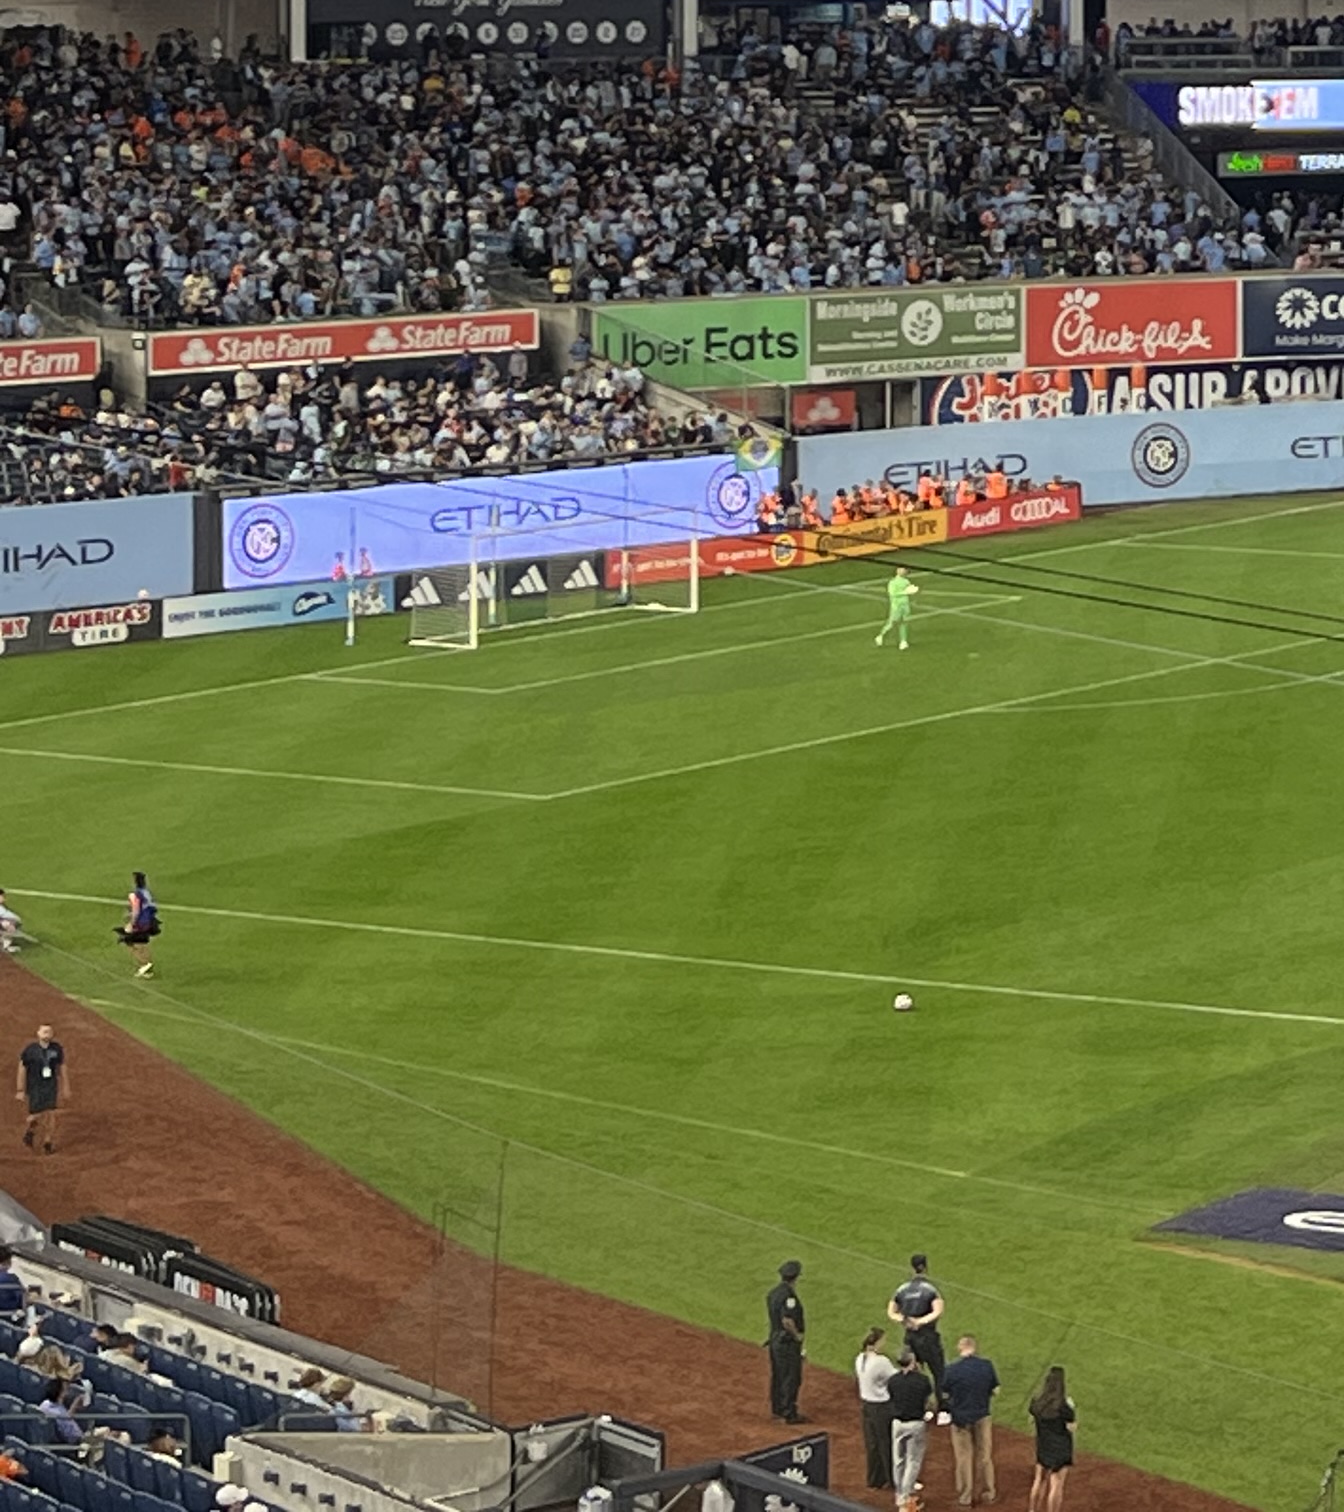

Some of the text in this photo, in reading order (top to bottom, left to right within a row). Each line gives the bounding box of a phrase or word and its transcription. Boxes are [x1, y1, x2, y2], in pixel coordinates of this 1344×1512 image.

[1178, 86, 1267, 124] SMOKE
[603, 332, 694, 369] Uber
[705, 326, 799, 363] Eats
[1052, 307, 1212, 359] Chick-fil-A
[1275, 334, 1310, 346] Make
[825, 355, 1008, 377] WWW.CASSENACARE.COM
[430, 496, 581, 533] ETIHAD
[962, 506, 1000, 531] Audi
[50, 603, 151, 634] AMERICA'S
[81, 628, 120, 643] TIRE
